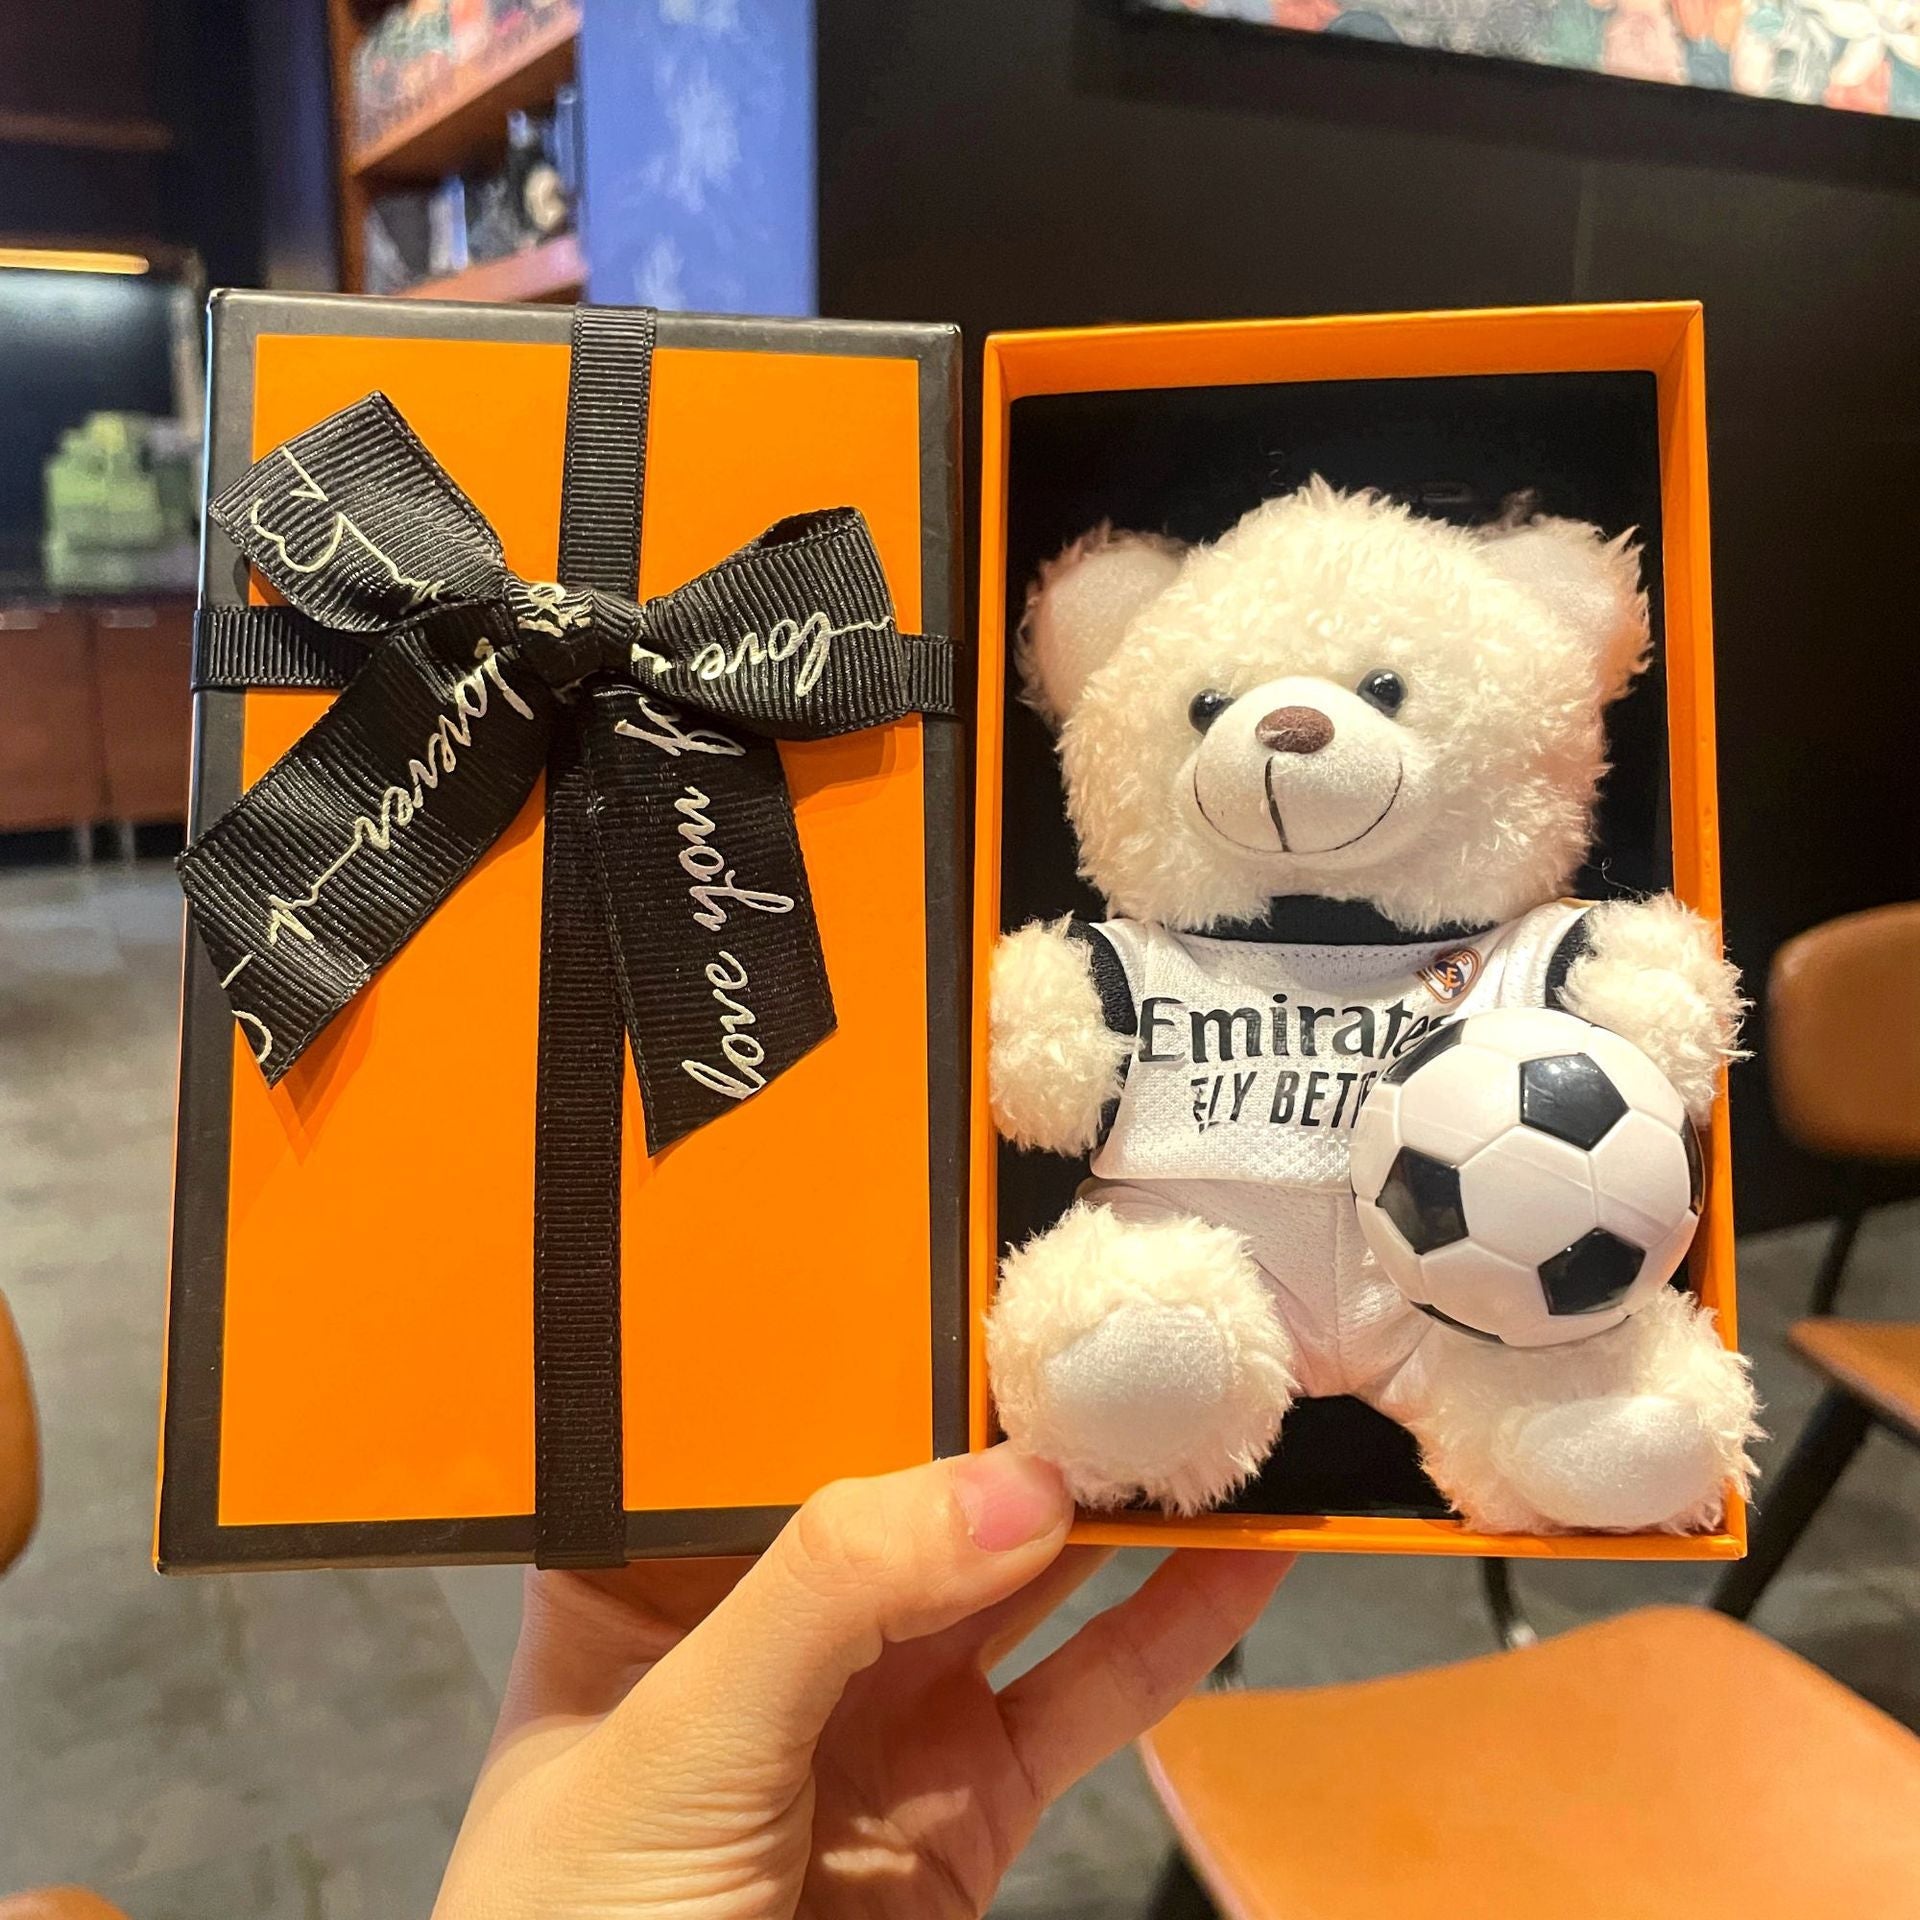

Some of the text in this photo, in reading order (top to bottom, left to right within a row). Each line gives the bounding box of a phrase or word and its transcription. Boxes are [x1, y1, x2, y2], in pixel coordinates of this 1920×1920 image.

[691, 611, 832, 698] love
[674, 785, 795, 932] you
[681, 950, 766, 1101] love
